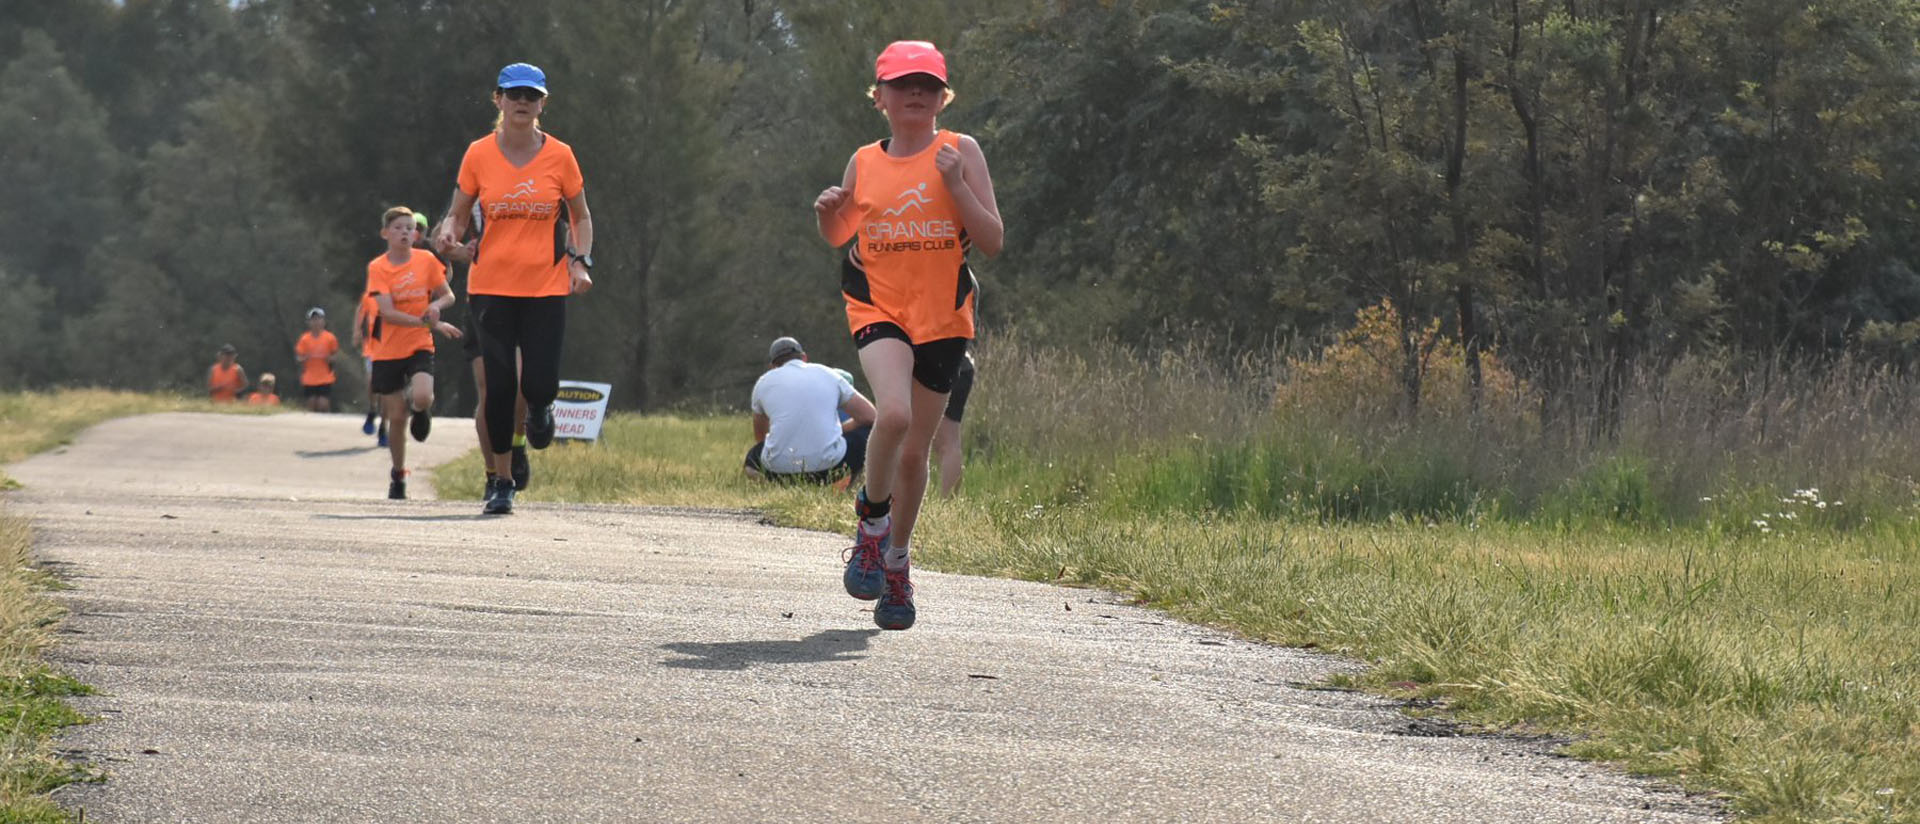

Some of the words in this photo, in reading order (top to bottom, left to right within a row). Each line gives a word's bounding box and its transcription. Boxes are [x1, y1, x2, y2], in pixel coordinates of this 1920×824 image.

[866, 220, 956, 240] ORANGE
[868, 241, 922, 253] RUNNERS
[923, 239, 955, 251] CLUB
[556, 390, 601, 401] AUTION
[555, 408, 597, 420] NNERS
[556, 423, 585, 434] HEAD
